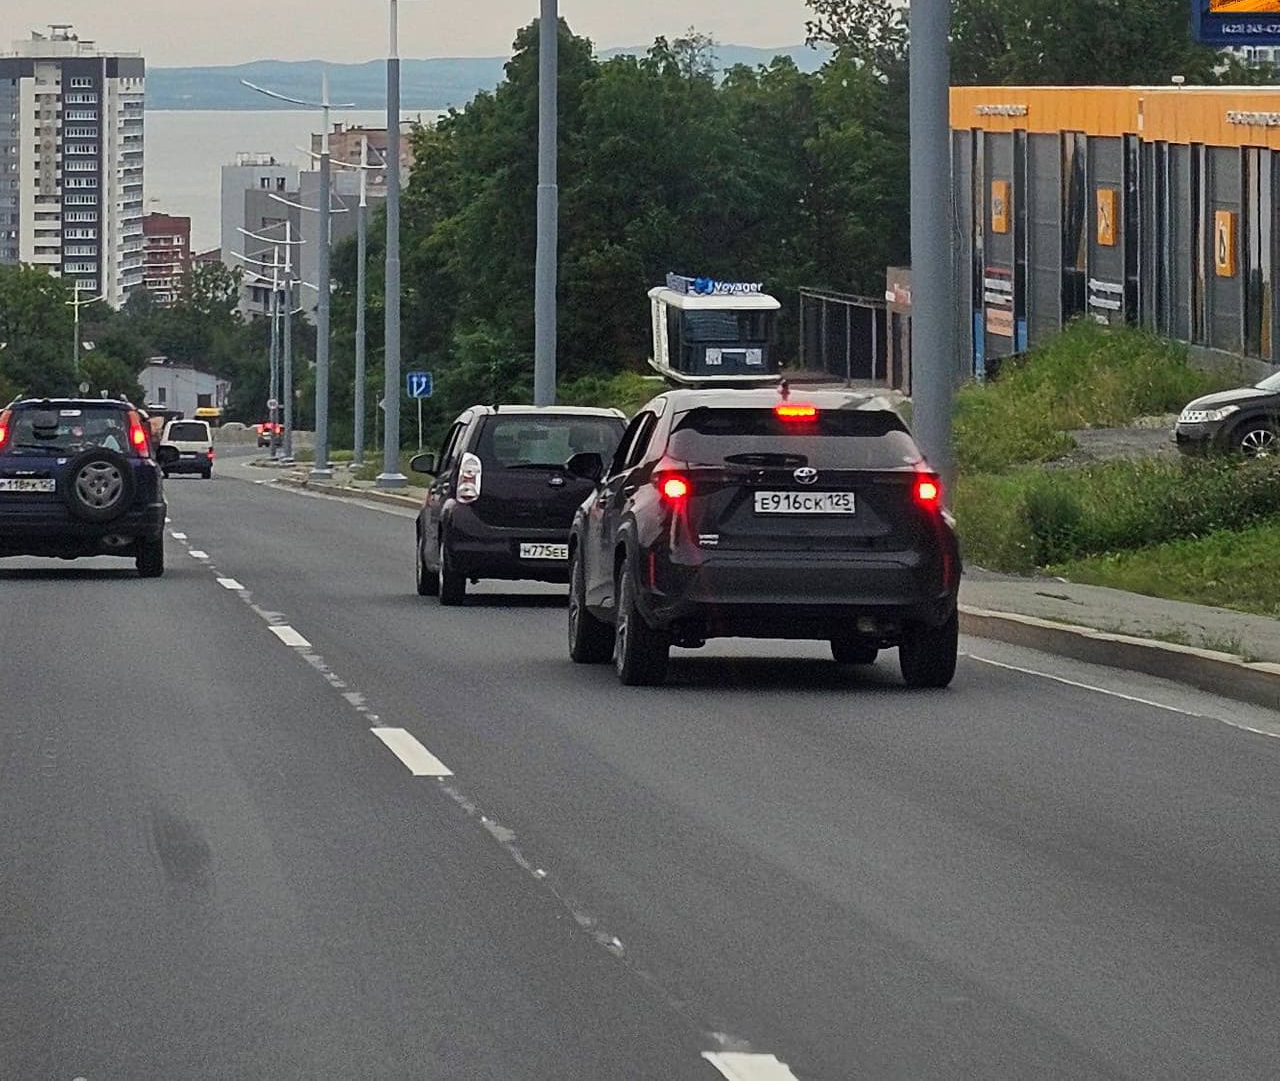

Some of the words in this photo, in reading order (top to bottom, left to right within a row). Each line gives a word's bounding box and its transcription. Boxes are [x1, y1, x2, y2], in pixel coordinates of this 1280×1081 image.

[714, 281, 763, 293] Voyager
[760, 494, 823, 510] Е916СК
[827, 494, 851, 507] 125
